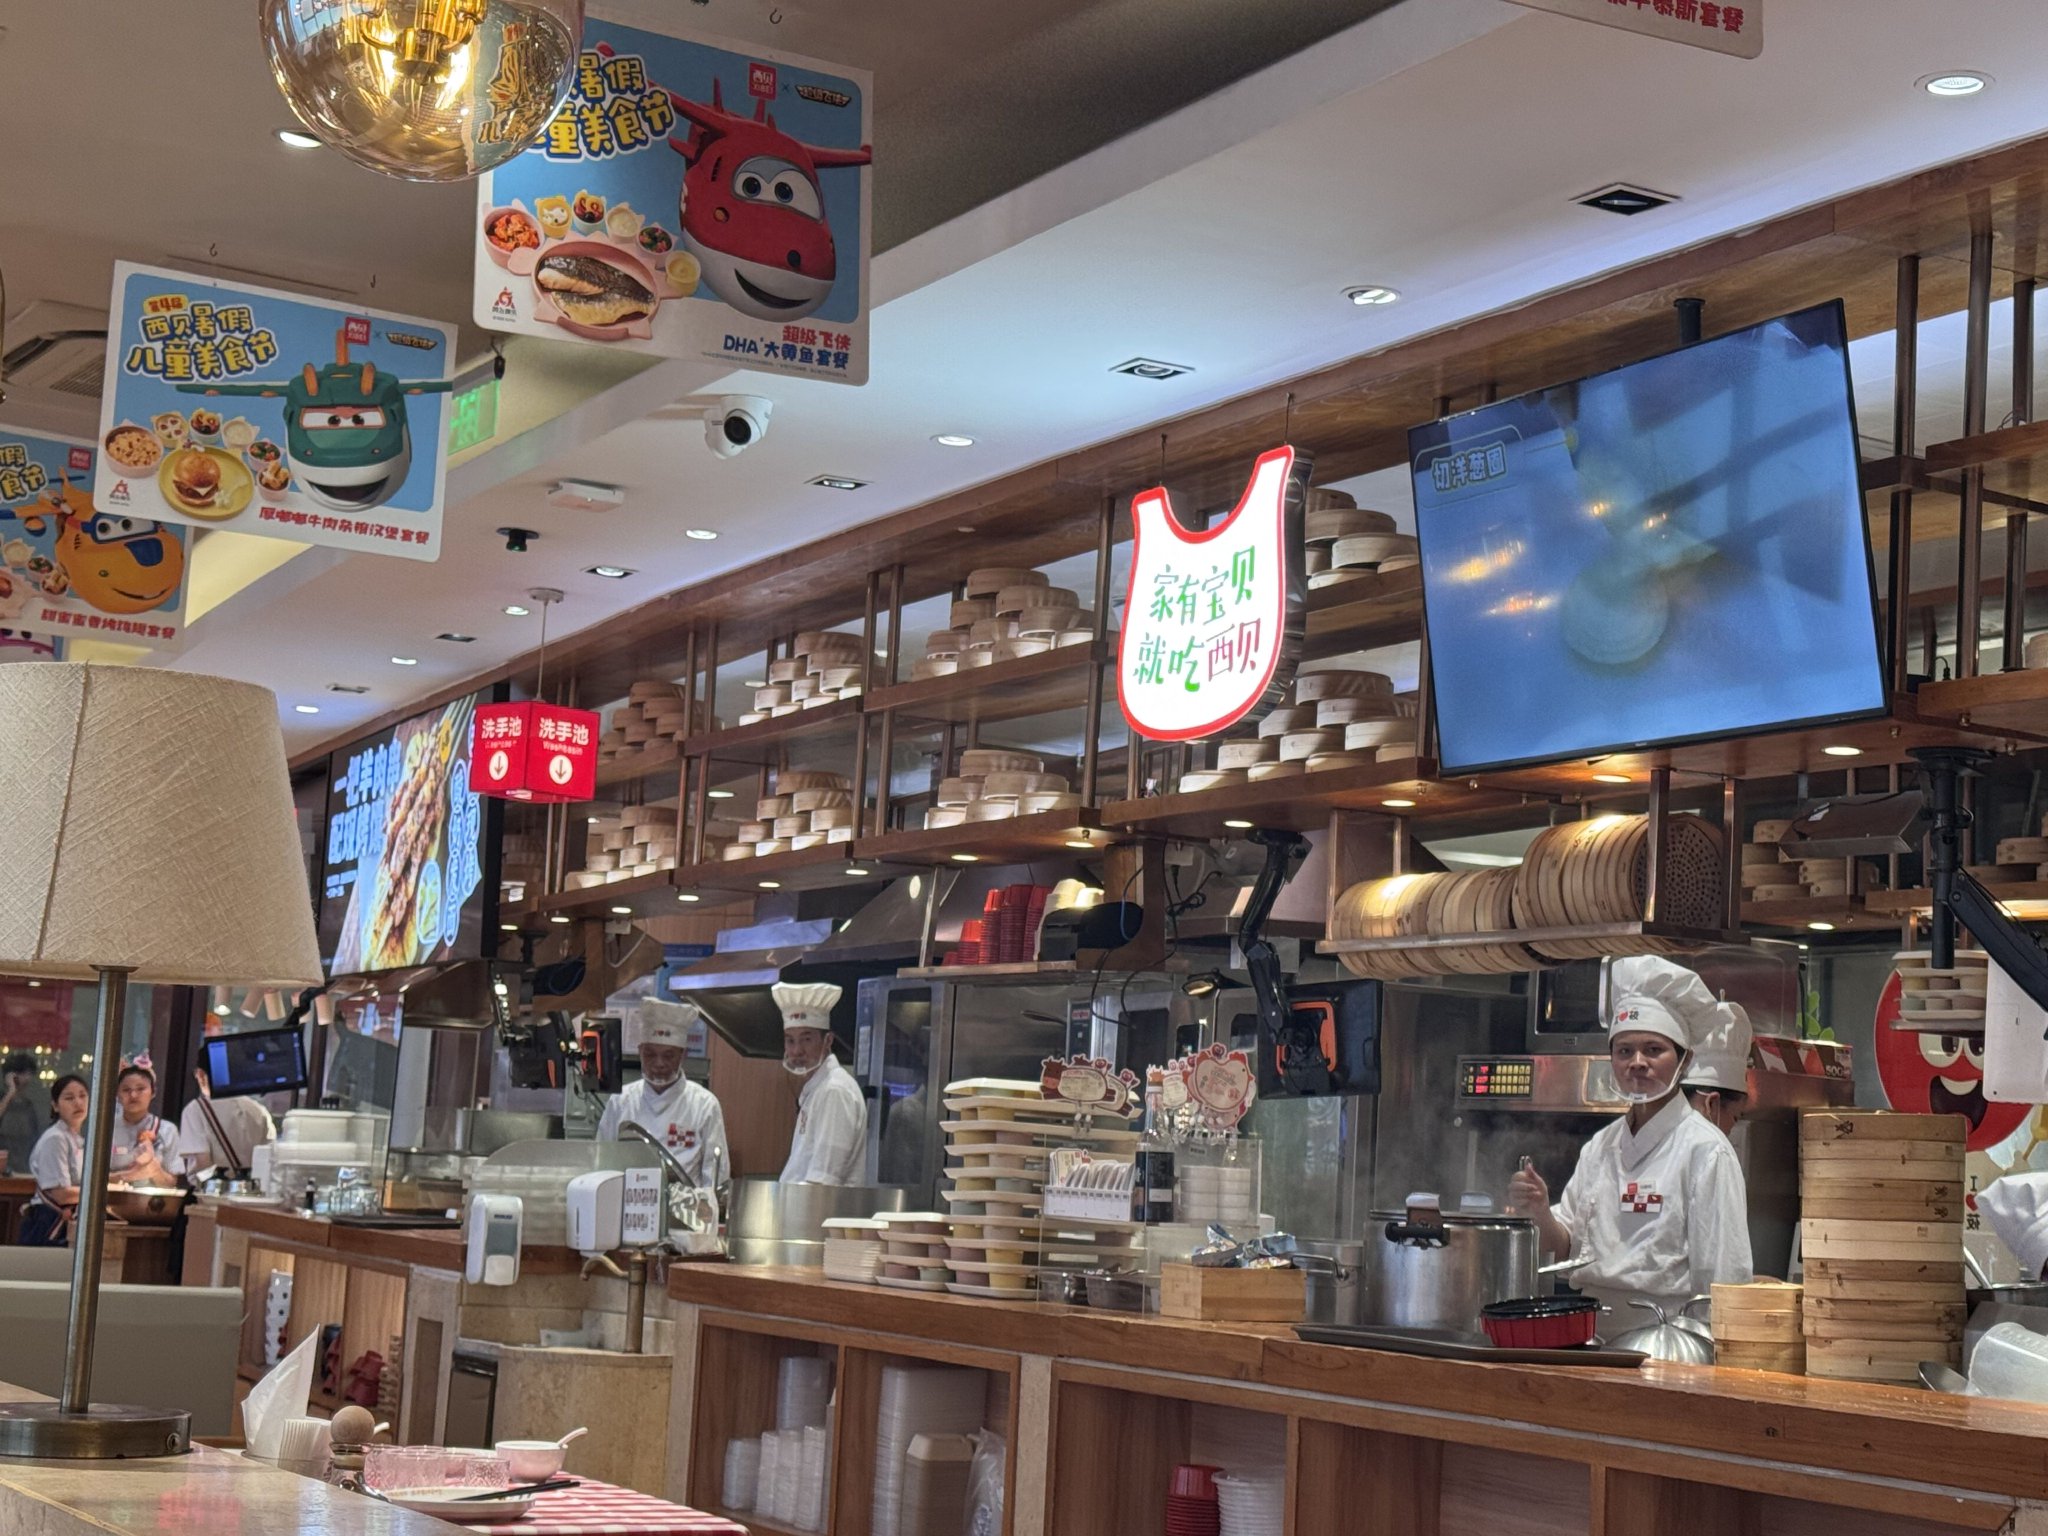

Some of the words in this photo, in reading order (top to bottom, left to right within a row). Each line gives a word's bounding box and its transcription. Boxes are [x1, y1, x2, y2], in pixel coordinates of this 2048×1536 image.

[571, 52, 645, 100] 暑假
[530, 90, 675, 157] 童美食节
[143, 303, 253, 341] 西贝暑假
[782, 325, 851, 351] 超级飞侠
[127, 329, 276, 379] 儿童美食节
[1433, 445, 1506, 490] 切洋葱圈
[1149, 545, 1255, 626] 家有宝贝
[1132, 617, 1261, 692] 就吃西贝
[481, 715, 523, 739] 洗手池
[538, 717, 590, 746] 洗手池
